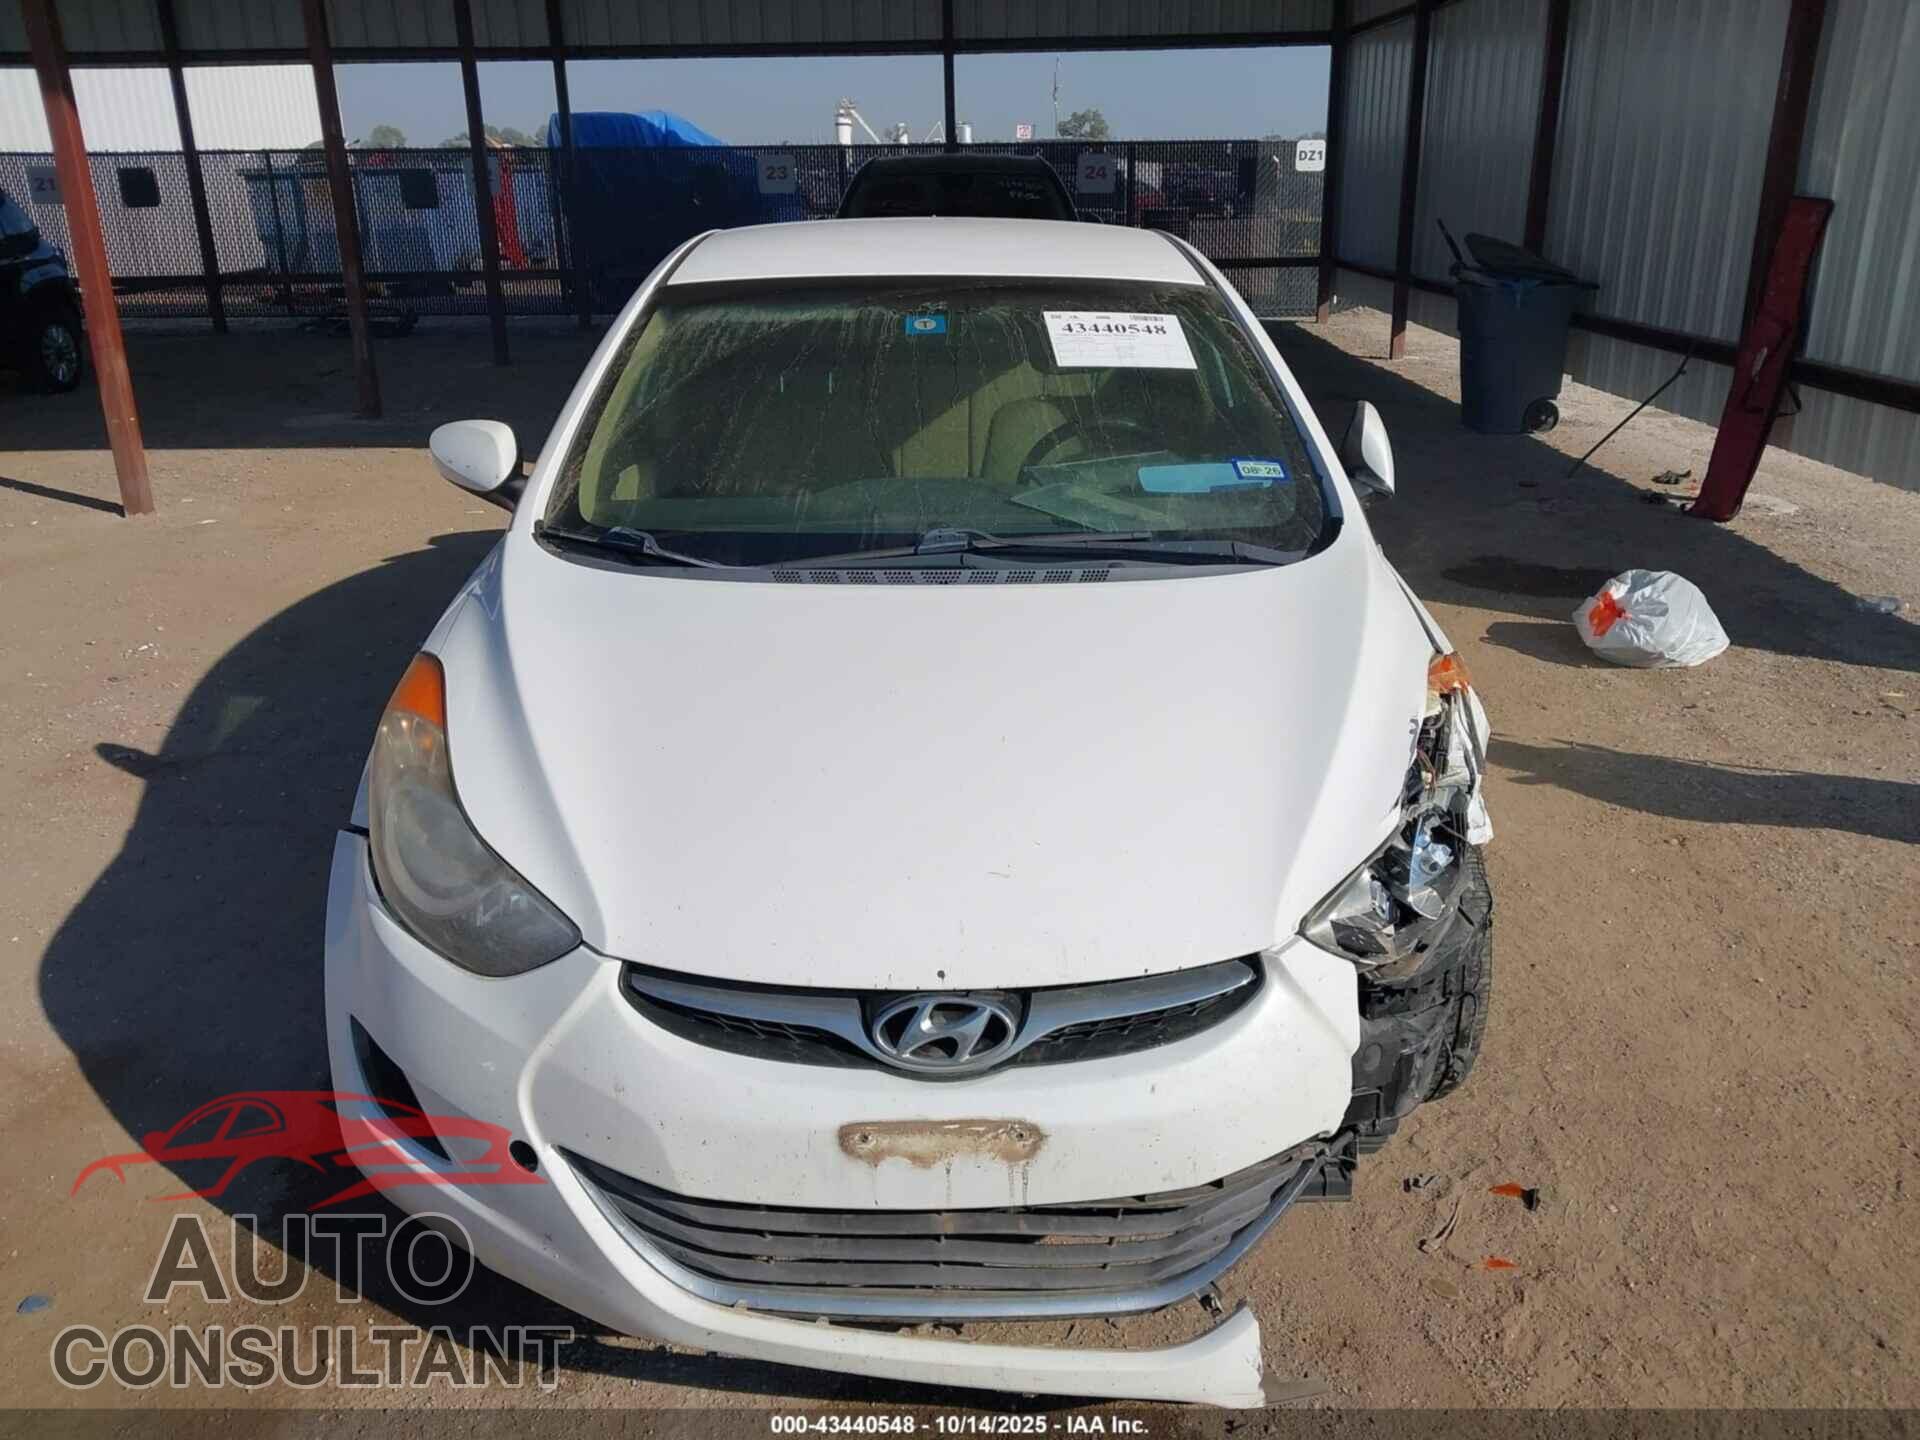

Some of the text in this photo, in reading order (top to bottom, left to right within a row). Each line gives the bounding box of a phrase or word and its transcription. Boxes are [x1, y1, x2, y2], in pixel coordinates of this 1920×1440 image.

[1298, 150, 1323, 161] DZ1
[766, 165, 787, 180] 23
[1085, 165, 1106, 180] 24
[1062, 322, 1167, 335] 43440548
